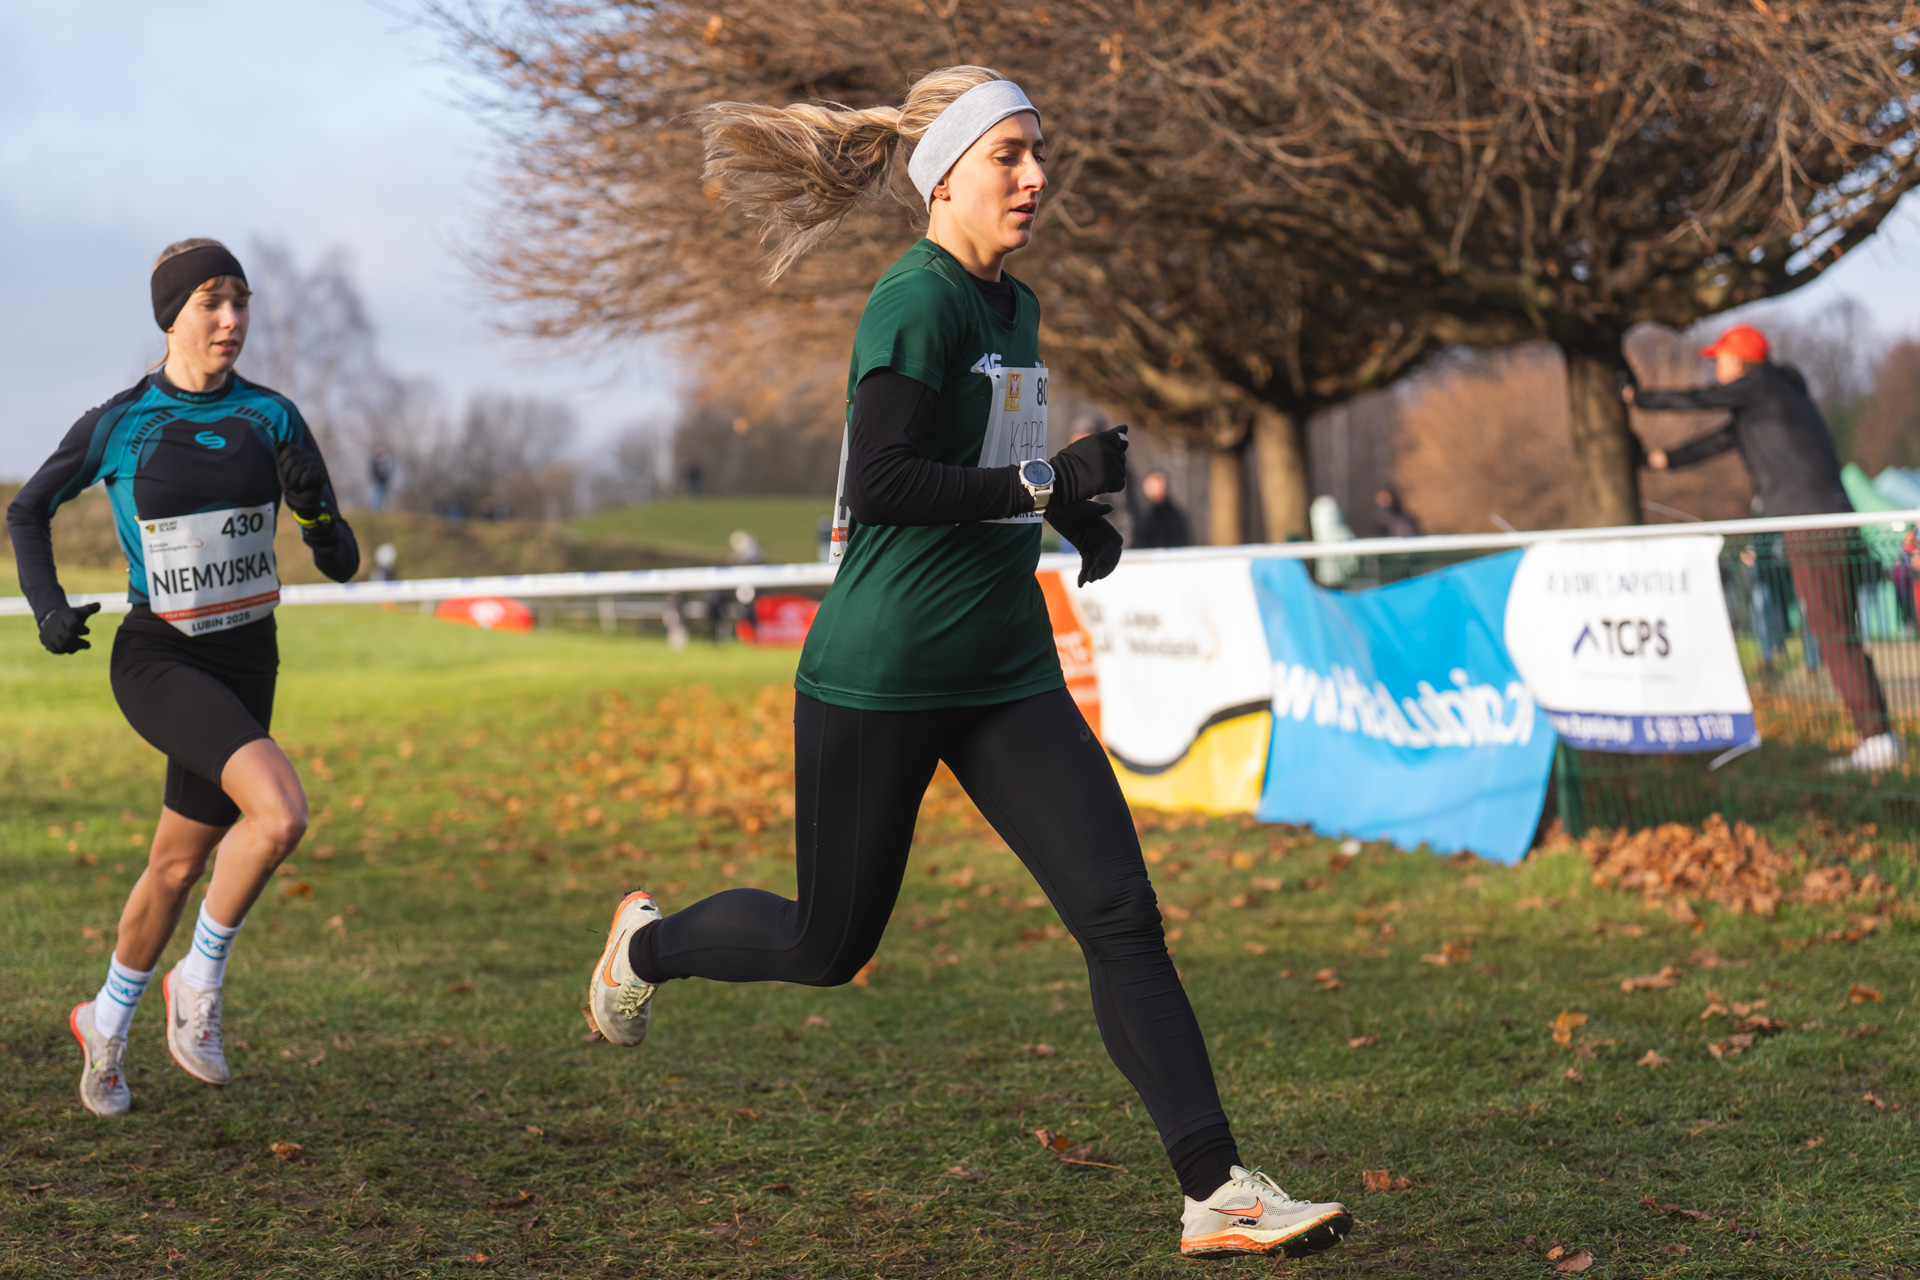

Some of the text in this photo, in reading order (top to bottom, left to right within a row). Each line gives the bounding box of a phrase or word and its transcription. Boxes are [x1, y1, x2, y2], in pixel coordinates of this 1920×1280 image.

[221, 512, 264, 539] 430
[152, 551, 272, 596] NIEMYJSKA
[191, 611, 250, 632] LUBIN 2025
